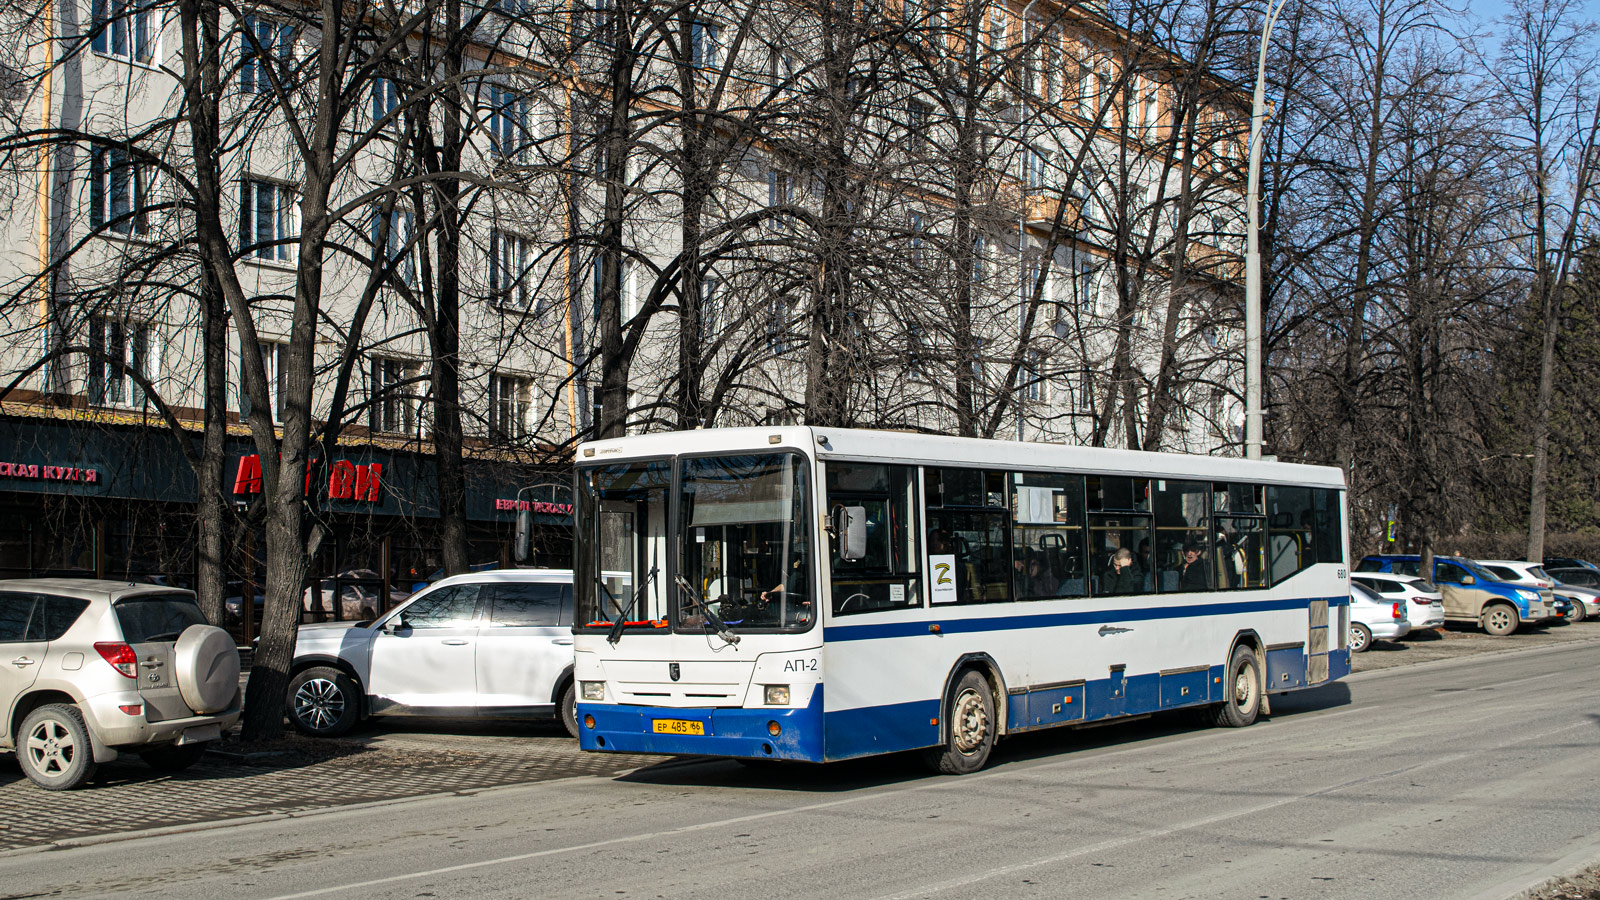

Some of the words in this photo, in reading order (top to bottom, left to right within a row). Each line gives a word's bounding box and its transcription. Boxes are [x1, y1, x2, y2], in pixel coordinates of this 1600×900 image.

[1337, 569, 1346, 579] 680
[783, 658, 817, 672] АП-2
[657, 723, 668, 731] ЕР
[671, 721, 688, 732] 485
